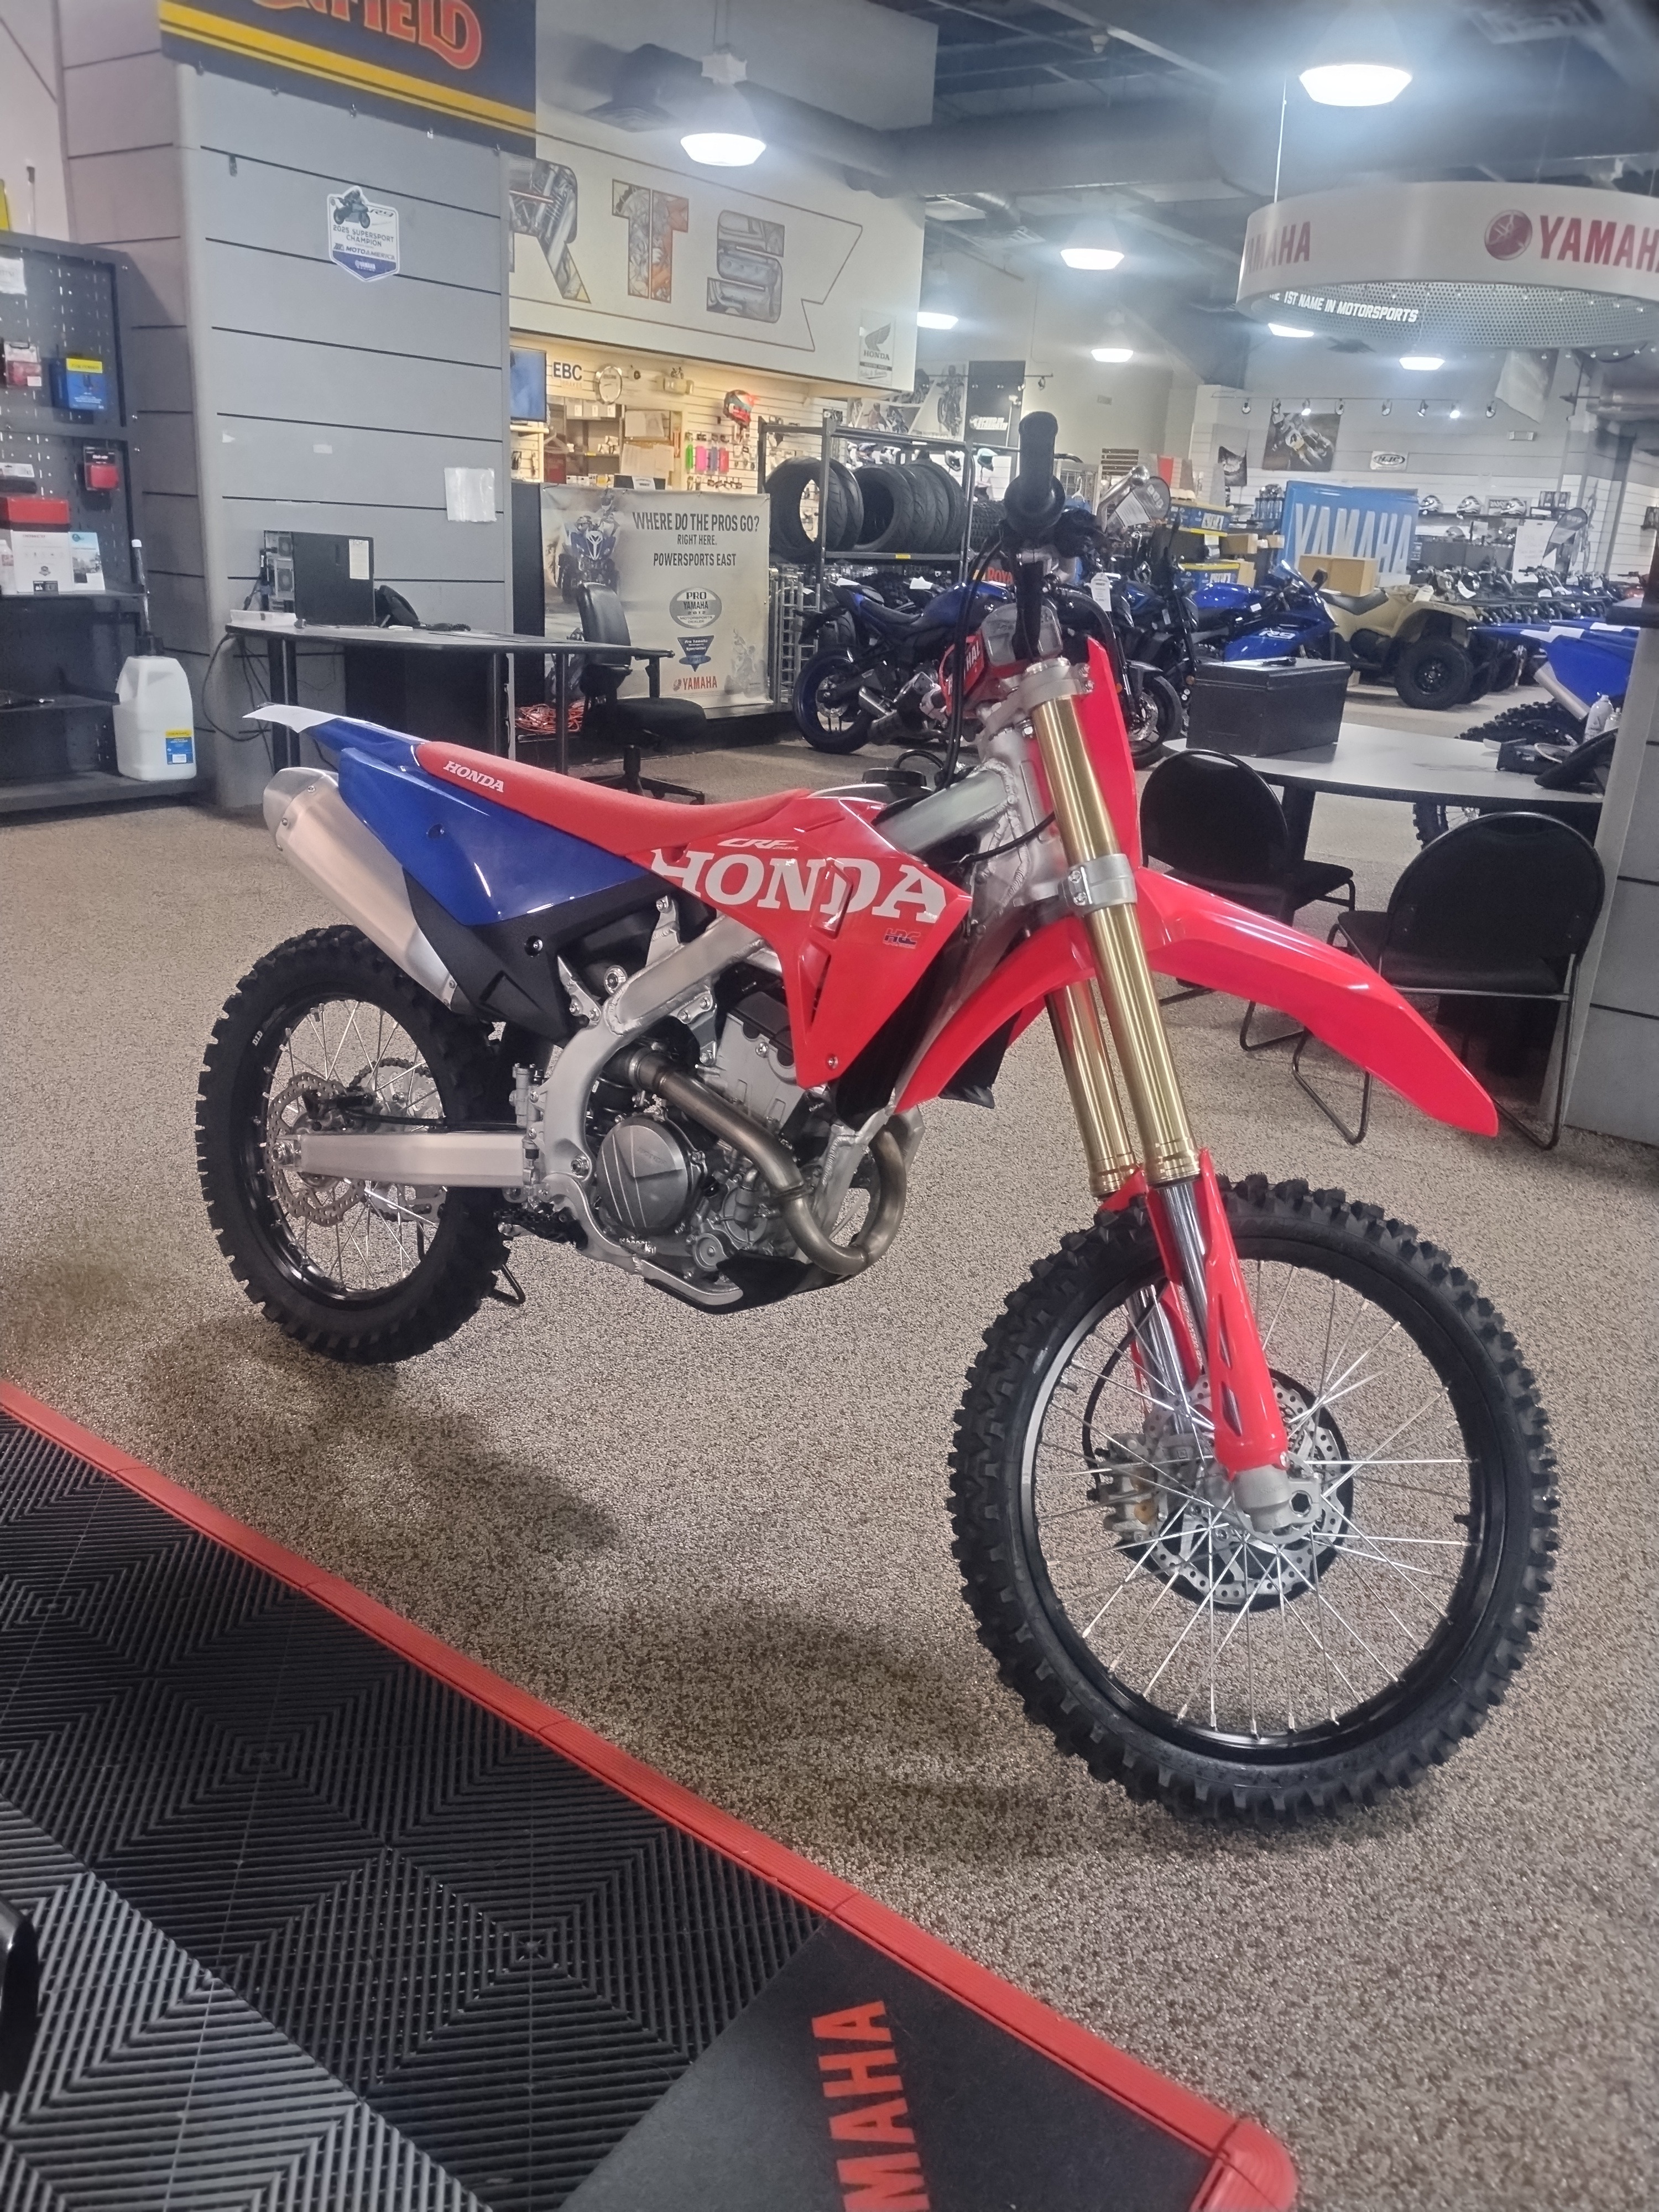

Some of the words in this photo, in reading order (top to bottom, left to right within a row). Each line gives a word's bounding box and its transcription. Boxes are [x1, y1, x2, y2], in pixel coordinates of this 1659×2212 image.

[333, 225, 349, 233] 2025
[352, 229, 394, 243] SUPERSPORT
[346, 234, 382, 247] CHAMPION
[1540, 215, 1659, 274] YAMAH
[346, 246, 395, 260] MOTOAMERICA
[1298, 294, 1324, 311] NAME
[1324, 298, 1337, 314] IN
[1336, 301, 1419, 323] MOTORSPORTS
[863, 349, 890, 361] HONDA
[554, 361, 582, 381] EBC
[562, 380, 582, 389] BRAKES
[632, 512, 672, 530] WHERE
[675, 513, 688, 531] DO
[690, 513, 709, 531] THE
[711, 514, 738, 531] PROS
[740, 515, 760, 532] GO?
[677, 534, 697, 545] RIGHT
[698, 534, 718, 546] HERE.
[1294, 503, 1412, 575] YAMAHA
[653, 553, 714, 566] POWERSPORTS
[717, 553, 737, 566] EAST
[686, 592, 707, 600] PRO
[684, 601, 709, 609] YAMAHA
[1259, 629, 1296, 639] R9
[683, 676, 718, 690] YAMAHA
[443, 760, 504, 792] HONDA
[717, 838, 796, 849] CRF
[651, 849, 947, 924] HONDA
[884, 928, 921, 946] HRC
[811, 2001, 931, 2212] MAHA
